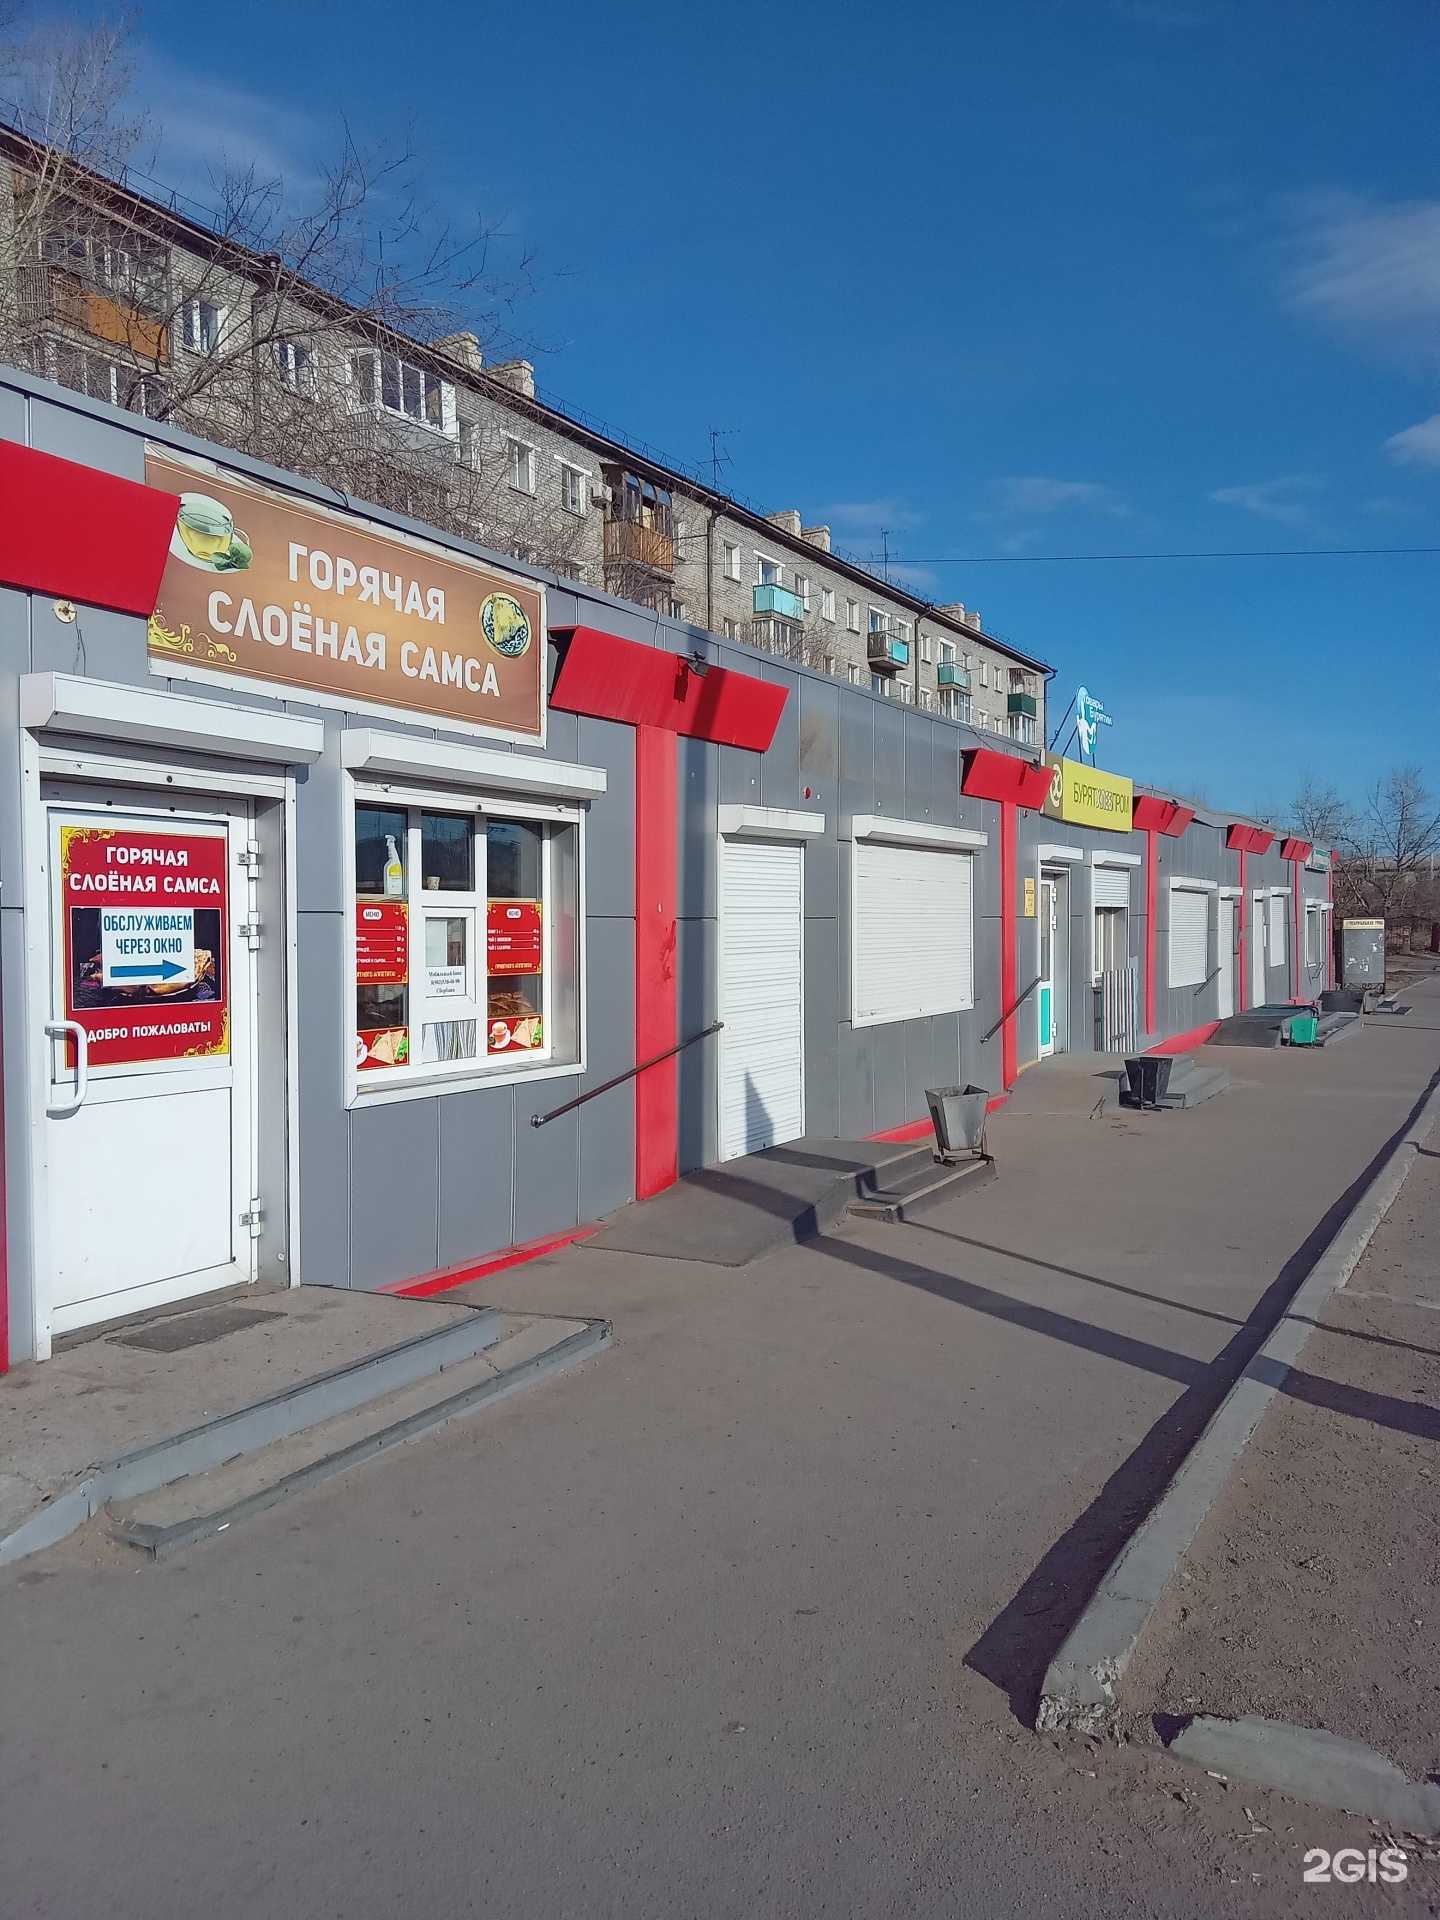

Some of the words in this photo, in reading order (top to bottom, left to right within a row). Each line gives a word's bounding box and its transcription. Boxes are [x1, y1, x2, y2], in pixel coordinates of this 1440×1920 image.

[288, 542, 445, 625] ГОРЯЧАЯ
[207, 590, 386, 671] СЛОЁНАЯ
[400, 641, 501, 697] САМСА
[106, 846, 188, 867] ГОРЯЧАЯ
[69, 871, 157, 893] СЛОЁНАЯ
[163, 876, 221, 894] САМСА
[103, 914, 193, 932] ОБСЛУЖИВАЕМ
[116, 938, 151, 955] ЧЕРЕЗ
[153, 937, 183, 954] ОКНО
[87, 1028, 128, 1043] ДОБРО
